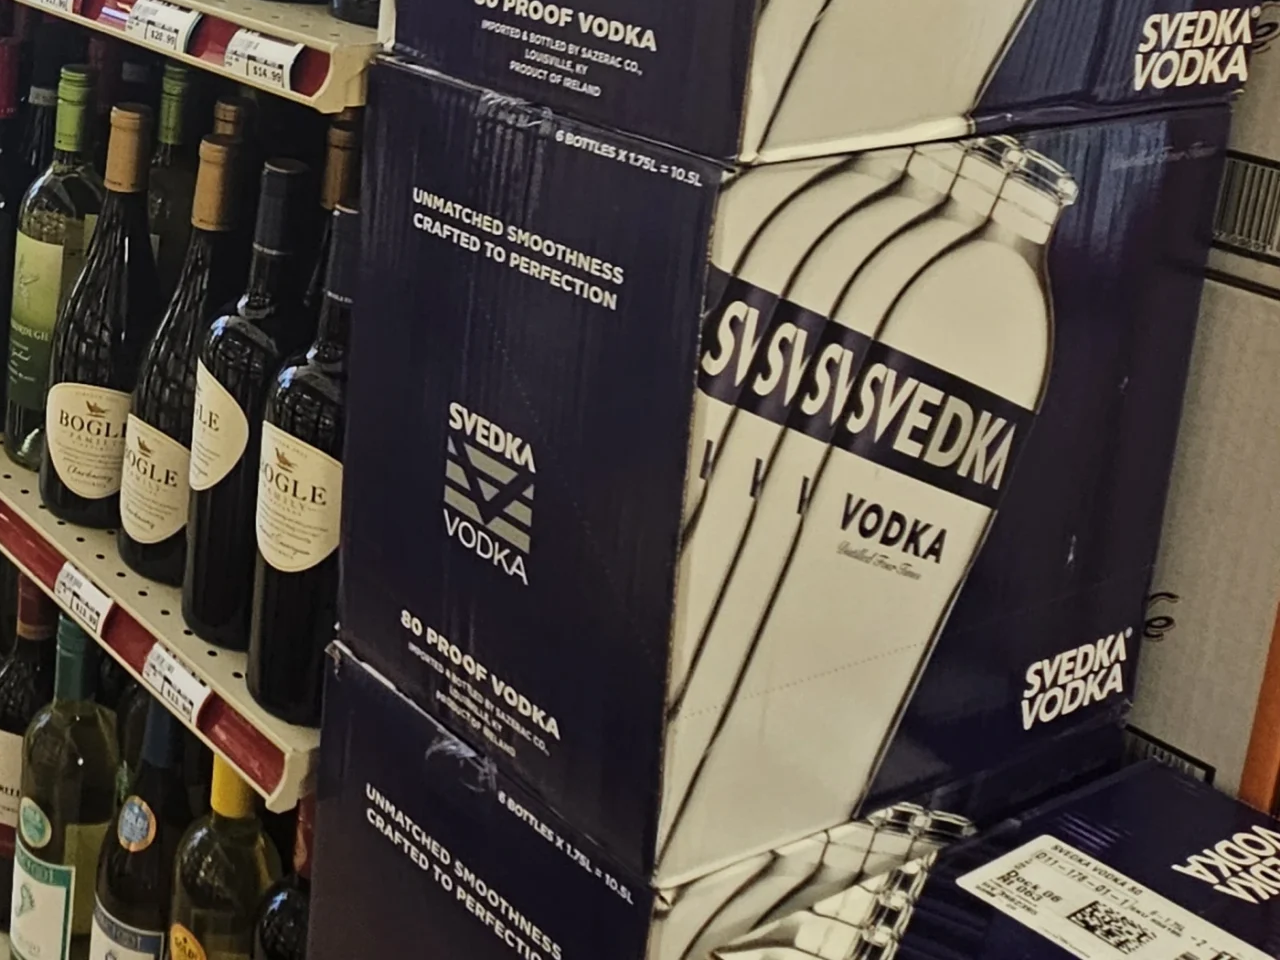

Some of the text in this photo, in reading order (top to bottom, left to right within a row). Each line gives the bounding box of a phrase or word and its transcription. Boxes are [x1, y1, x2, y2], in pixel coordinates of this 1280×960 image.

[481, 19, 521, 40] IMPORTED
[529, 32, 567, 52] BOTTLED
[568, 42, 580, 55] BY
[581, 46, 622, 68] SAZERAC
[524, 48, 589, 75] LOUISVILLE, KY
[578, 12, 657, 52] VODKA
[509, 60, 601, 97] PRODUCT OF IRELAND
[1133, 45, 1249, 91] VODKA
[555, 130, 564, 142] 6
[565, 132, 616, 159] BOTTLES
[617, 149, 626, 162] X
[627, 151, 658, 174] 1.75L
[670, 165, 702, 187] 10.5L
[412, 187, 624, 285] UNMATCHED SMOOTHNESS
[413, 212, 617, 311] CRAFTED TO PERFECTION
[448, 401, 536, 474] SVEDKA
[846, 362, 1018, 491] SVEDKA
[442, 508, 529, 586] VODKA
[839, 491, 948, 565] VODKA
[401, 609, 560, 741] 80 PROOF VODKA
[1020, 662, 1124, 731] VODKA
[507, 798, 554, 842] BOTTLES
[366, 782, 563, 960] UNMATCHED SMOOTHNESS
[366, 807, 542, 960] CRAFTED TO PERFECTIO
[1007, 869, 1040, 891] Dock
[1051, 844, 1090, 868] SVEDKA
